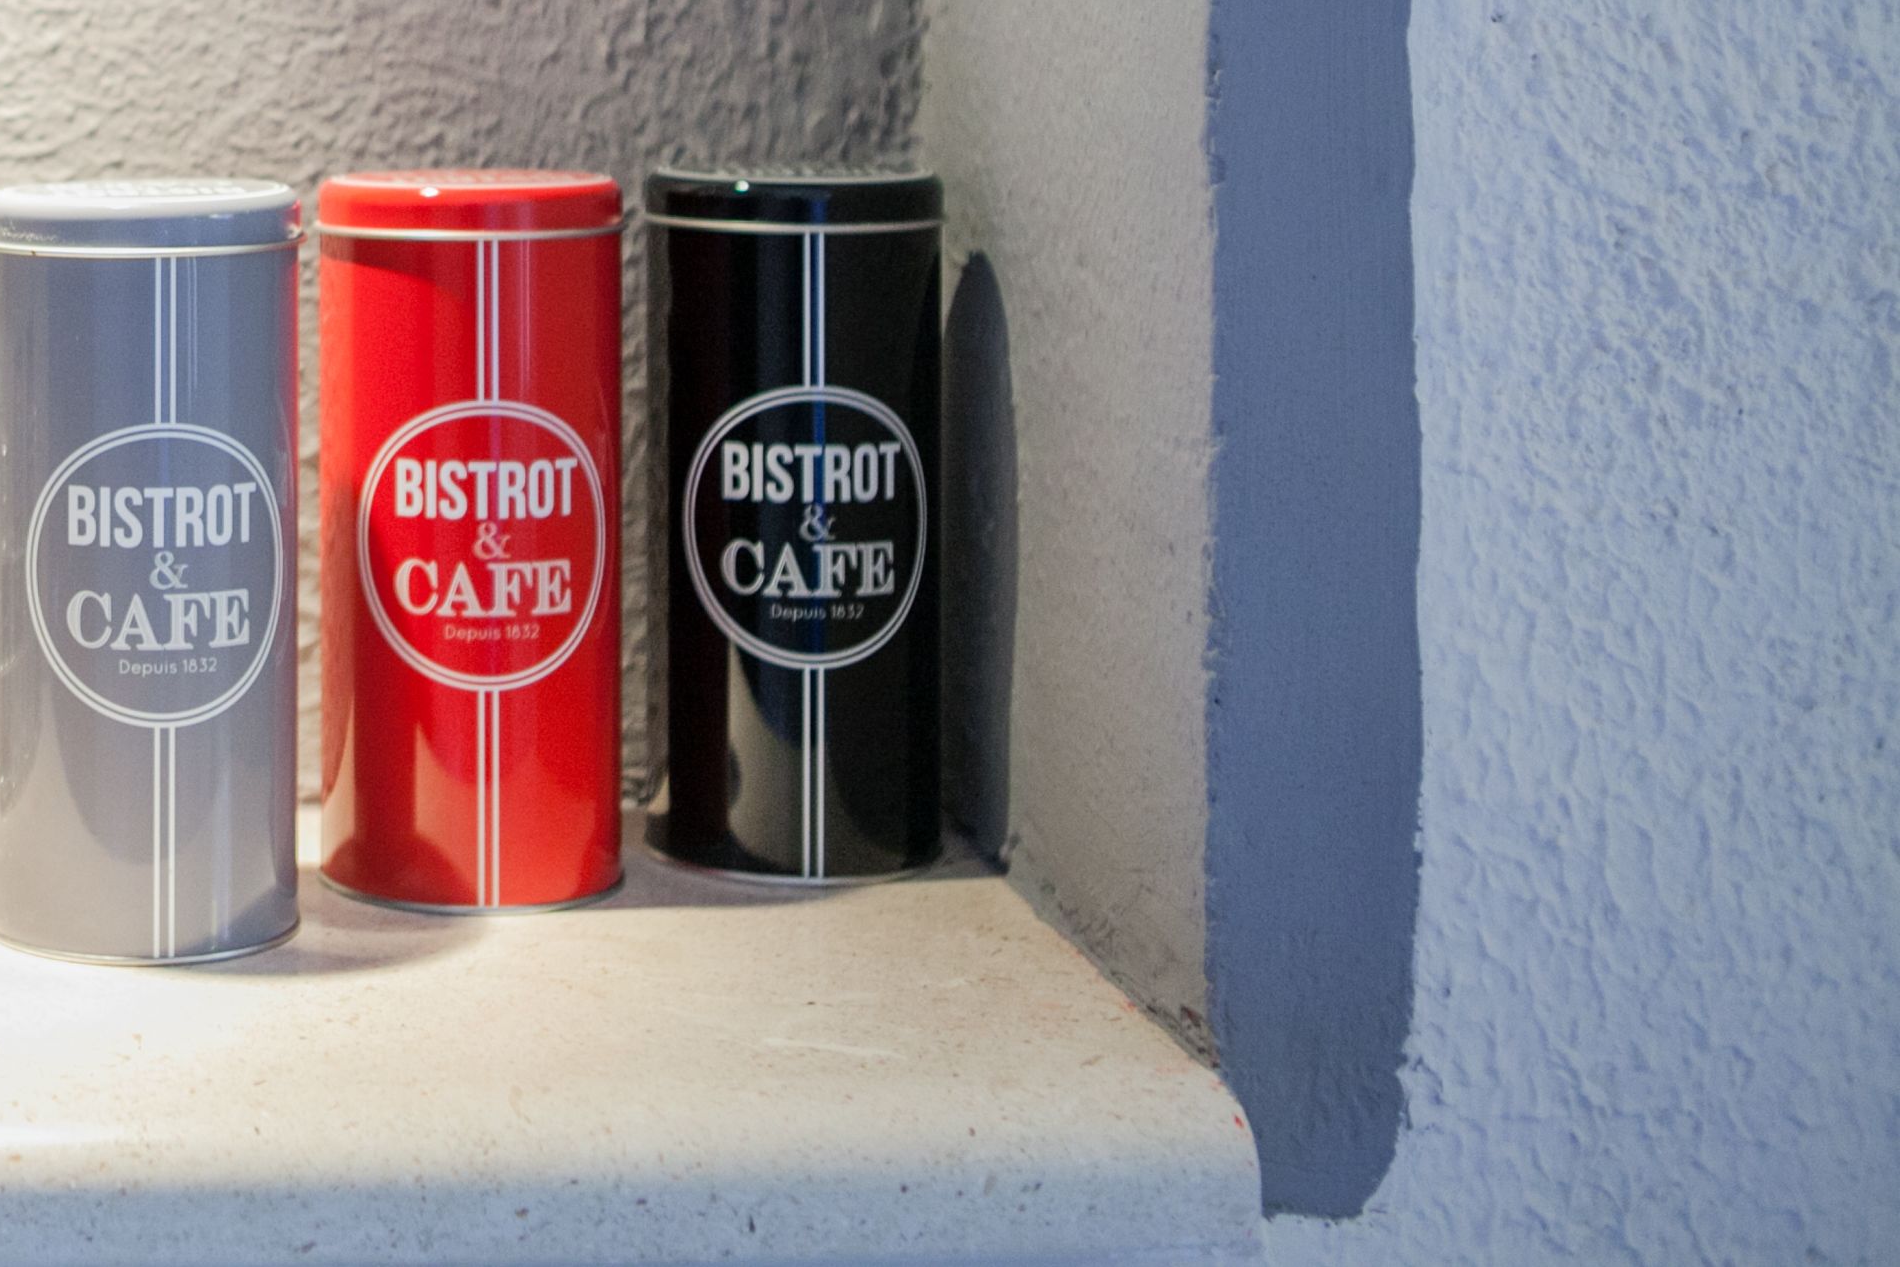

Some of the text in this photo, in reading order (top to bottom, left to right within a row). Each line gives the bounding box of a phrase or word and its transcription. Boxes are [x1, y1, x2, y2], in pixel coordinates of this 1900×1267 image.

[395, 457, 578, 521] BISTROT
[722, 440, 901, 504] BISTROT
[67, 482, 257, 549] BISTROT
[799, 503, 836, 542] &
[473, 521, 511, 560] &
[149, 551, 189, 590] &
[393, 558, 572, 617] CAFE
[720, 538, 895, 598] CAFE
[66, 588, 250, 651] CAFE
[444, 624, 541, 643] Depuis 1832
[770, 604, 826, 622] Depuis
[118, 657, 218, 677] Depuis 1832
